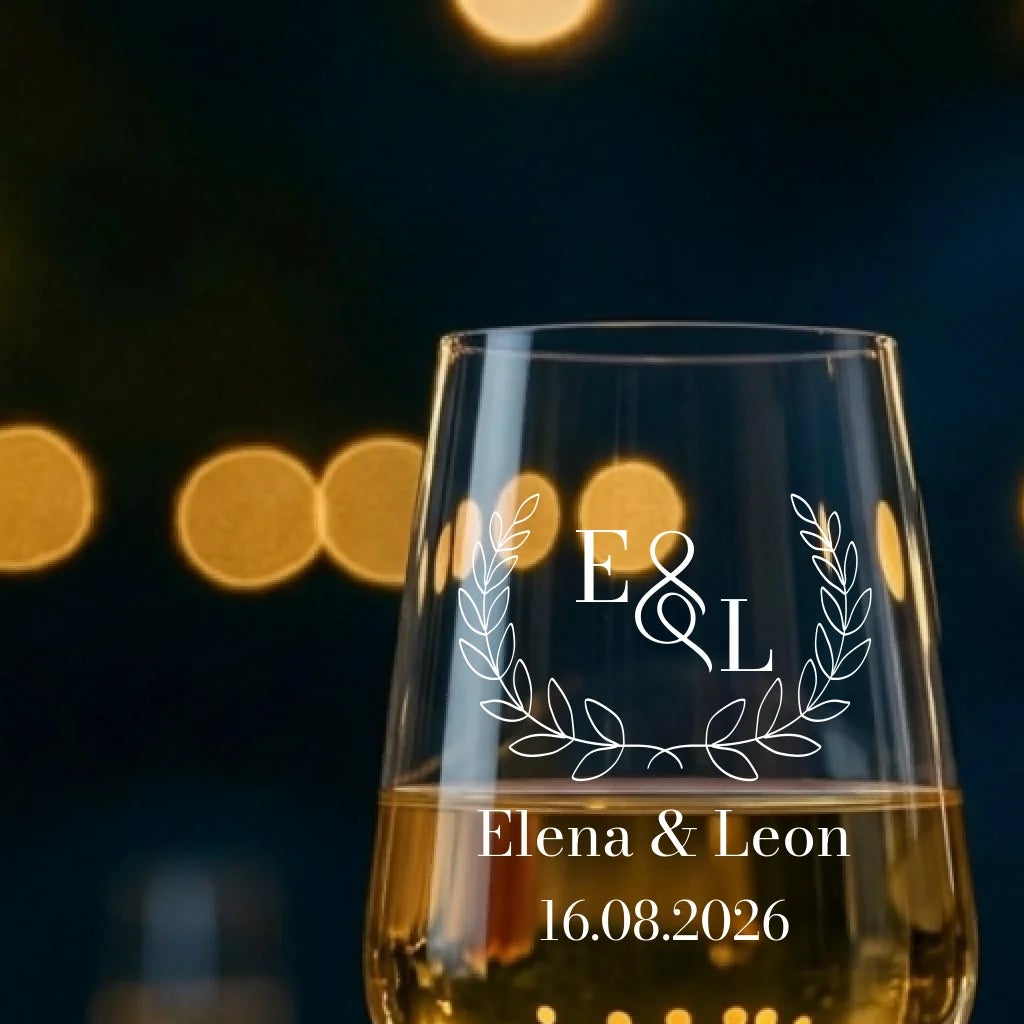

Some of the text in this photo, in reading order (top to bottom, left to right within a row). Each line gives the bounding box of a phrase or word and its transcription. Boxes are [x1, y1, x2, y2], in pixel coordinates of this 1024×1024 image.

[575, 529, 773, 672] E & L
[477, 808, 851, 857] Elena & Leon
[540, 899, 790, 941] 16.08.2026
